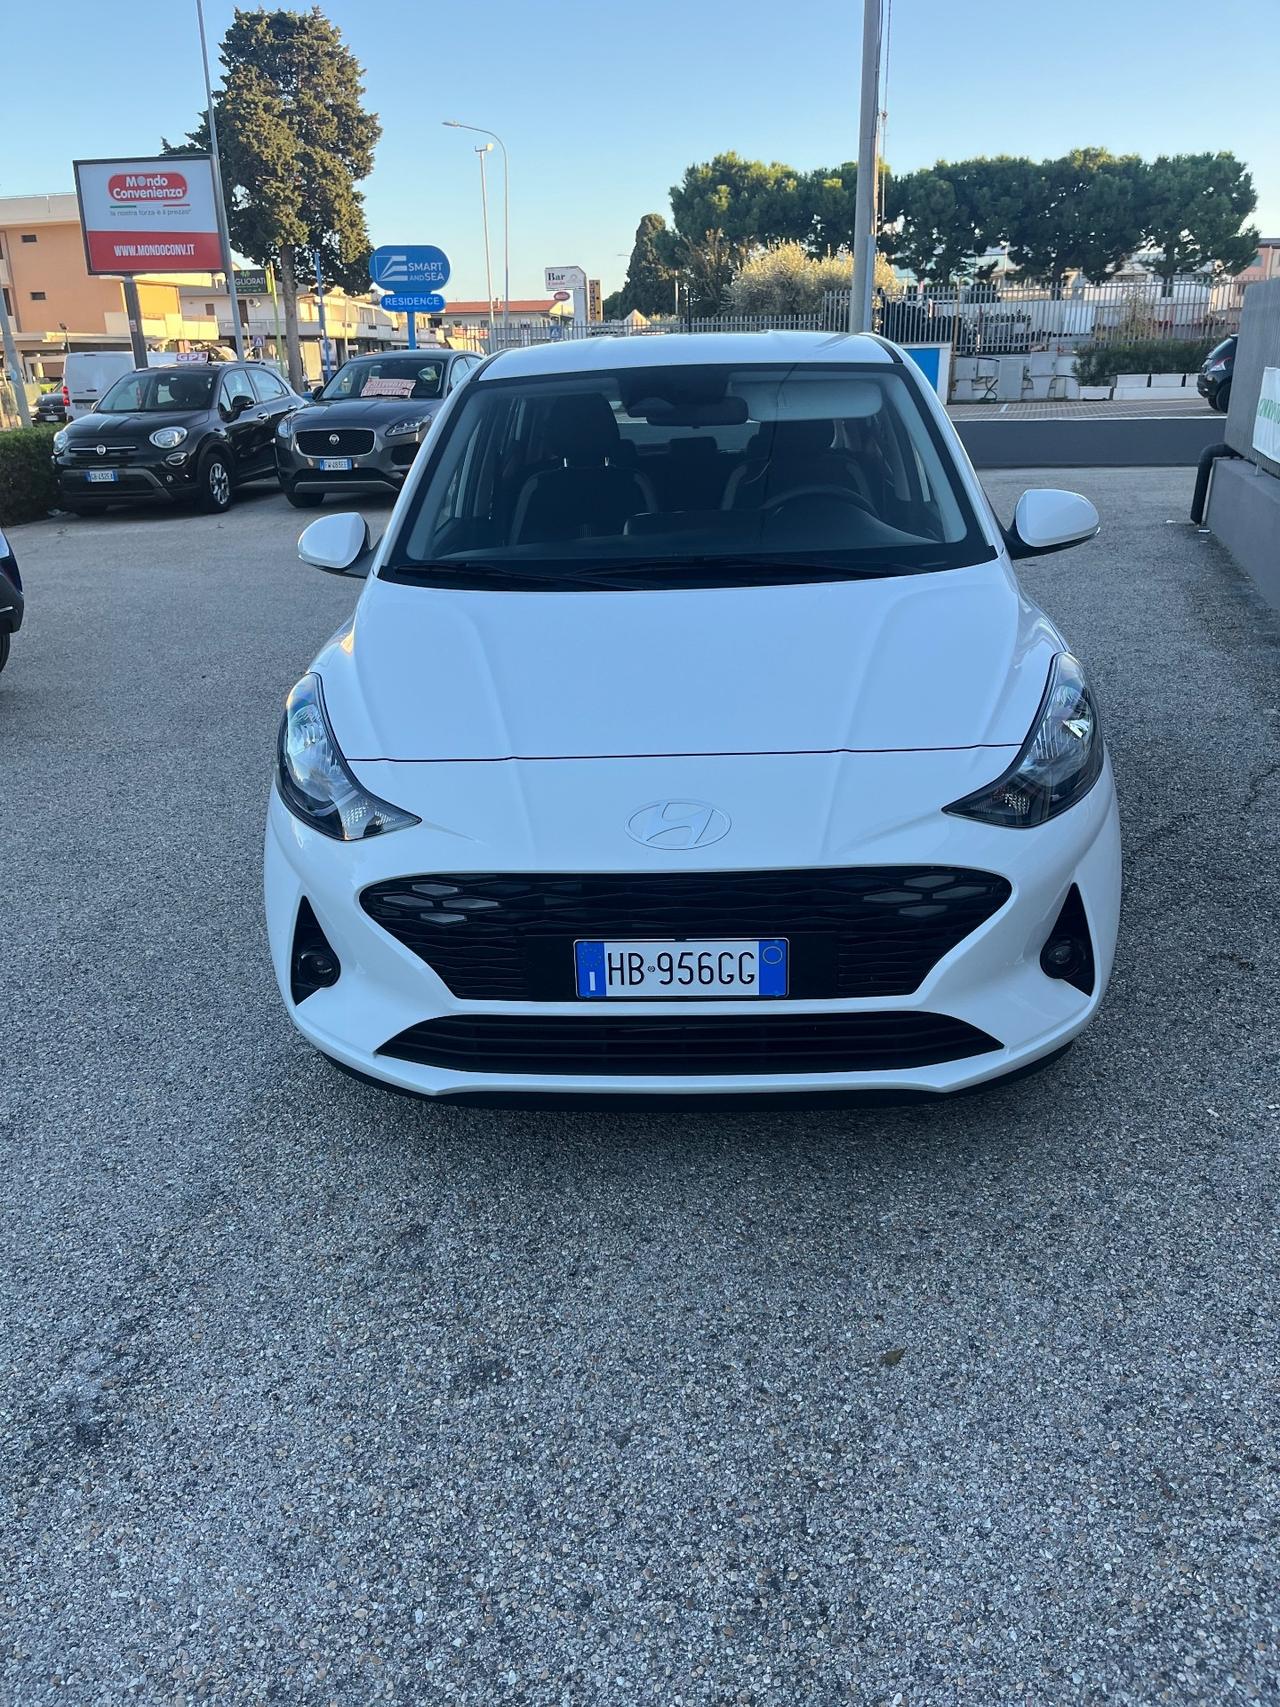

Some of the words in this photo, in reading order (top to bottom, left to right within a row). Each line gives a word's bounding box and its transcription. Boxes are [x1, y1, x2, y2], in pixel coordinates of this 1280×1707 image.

[126, 175, 168, 187] Mondo
[113, 187, 183, 198] Convenienza
[113, 244, 195, 257] WWW.MONDOCONV.IT
[408, 262, 443, 272] SMART
[548, 272, 566, 281] Bar
[384, 296, 440, 306] RESIDENCE
[177, 352, 207, 361] GPL
[607, 952, 645, 986] HB
[656, 951, 756, 985] 956GG
